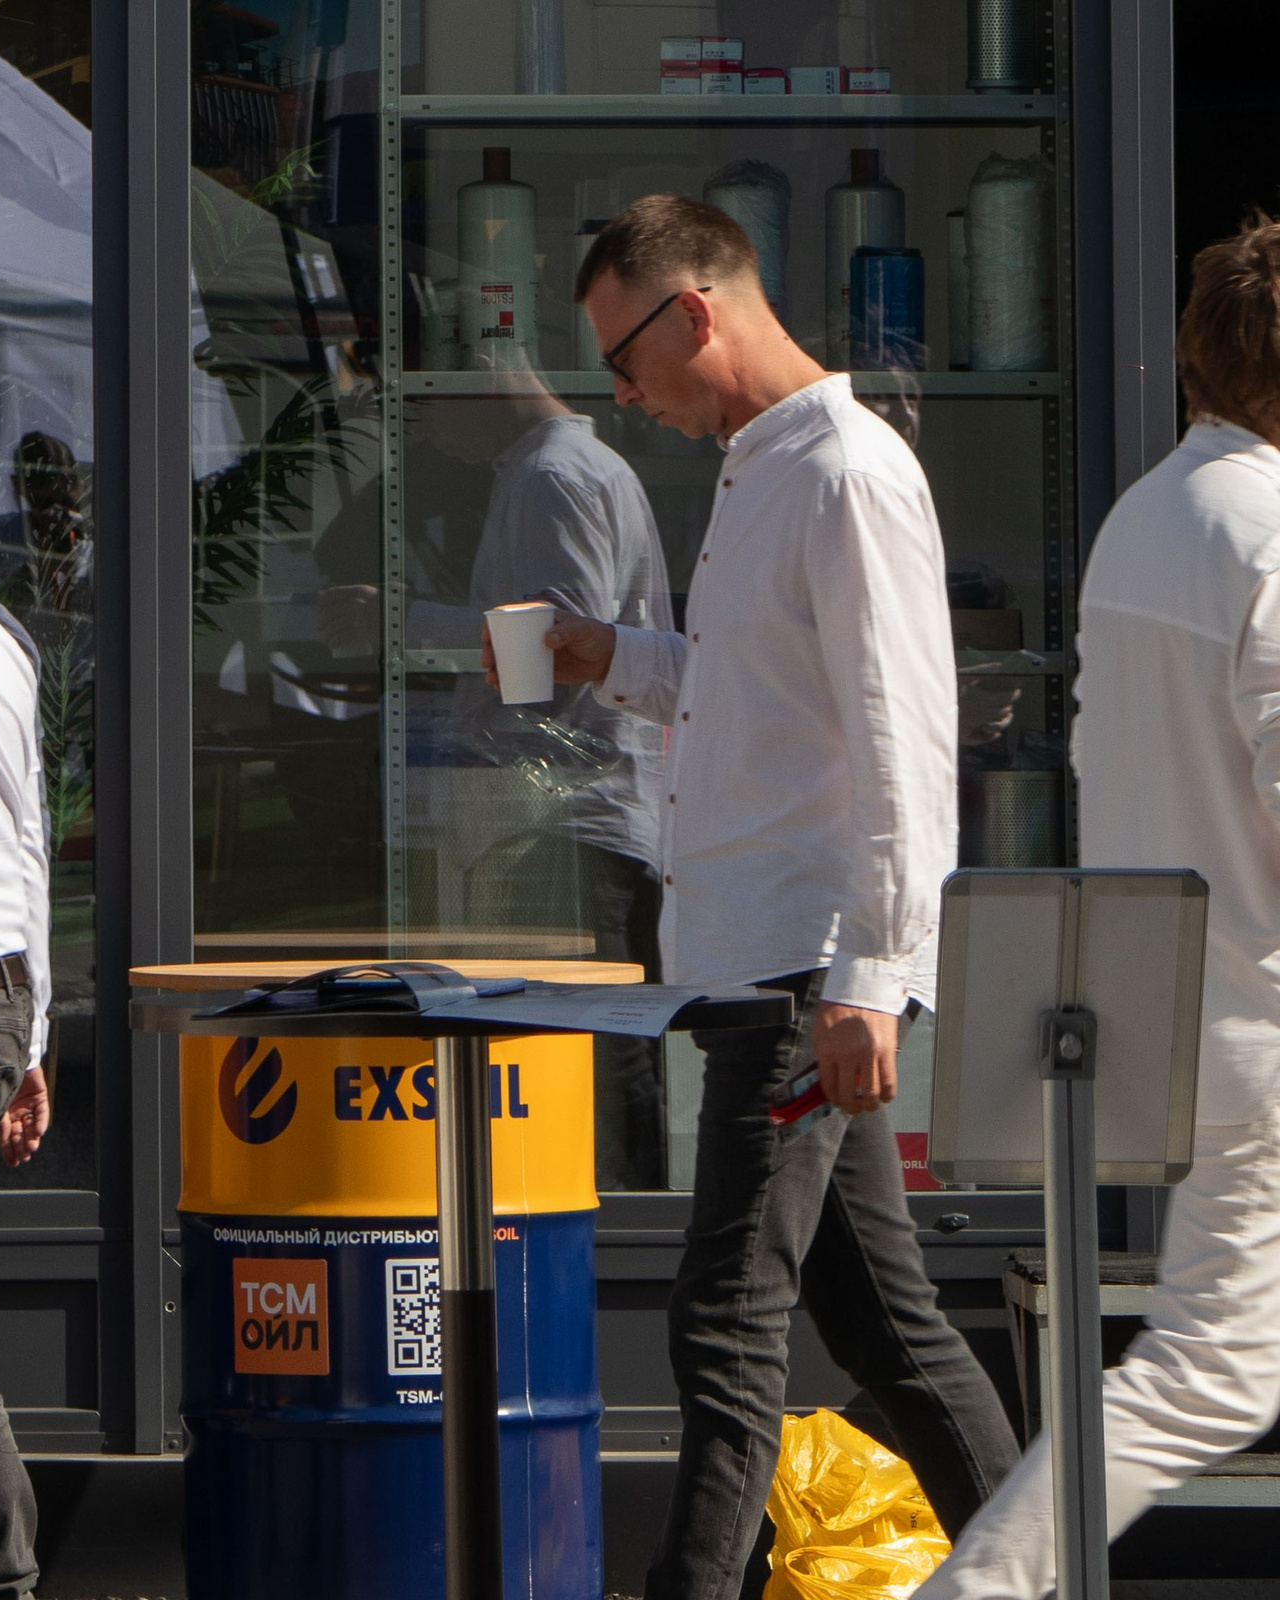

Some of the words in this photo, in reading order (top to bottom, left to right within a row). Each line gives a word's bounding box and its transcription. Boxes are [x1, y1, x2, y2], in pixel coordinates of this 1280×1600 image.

[334, 1063, 529, 1121] EXSIL
[213, 1226, 320, 1245] ОФИЦИАЛЬНЫЙ
[240, 1281, 317, 1314] ТСМ
[240, 1315, 320, 1352] ОЙЛ
